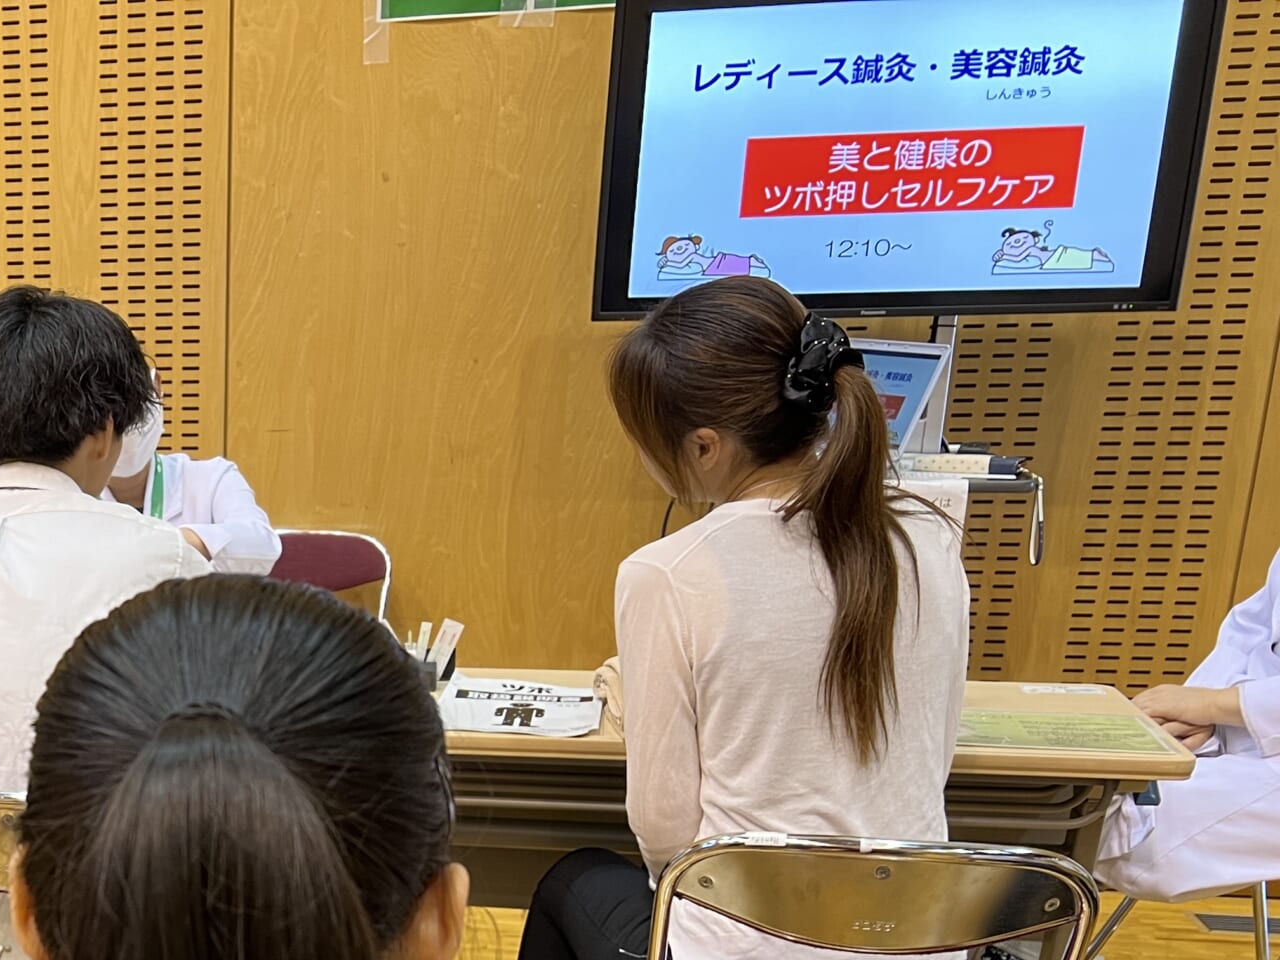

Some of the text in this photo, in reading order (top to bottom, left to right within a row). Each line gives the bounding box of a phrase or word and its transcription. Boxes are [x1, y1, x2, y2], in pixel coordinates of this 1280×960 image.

[694, 44, 1086, 92] レディース鍼灸・美容鍼灸
[985, 86, 1053, 101] しんきゅう
[828, 138, 993, 173] 美と健康の
[763, 174, 1056, 213] ツボ押しセルフケア
